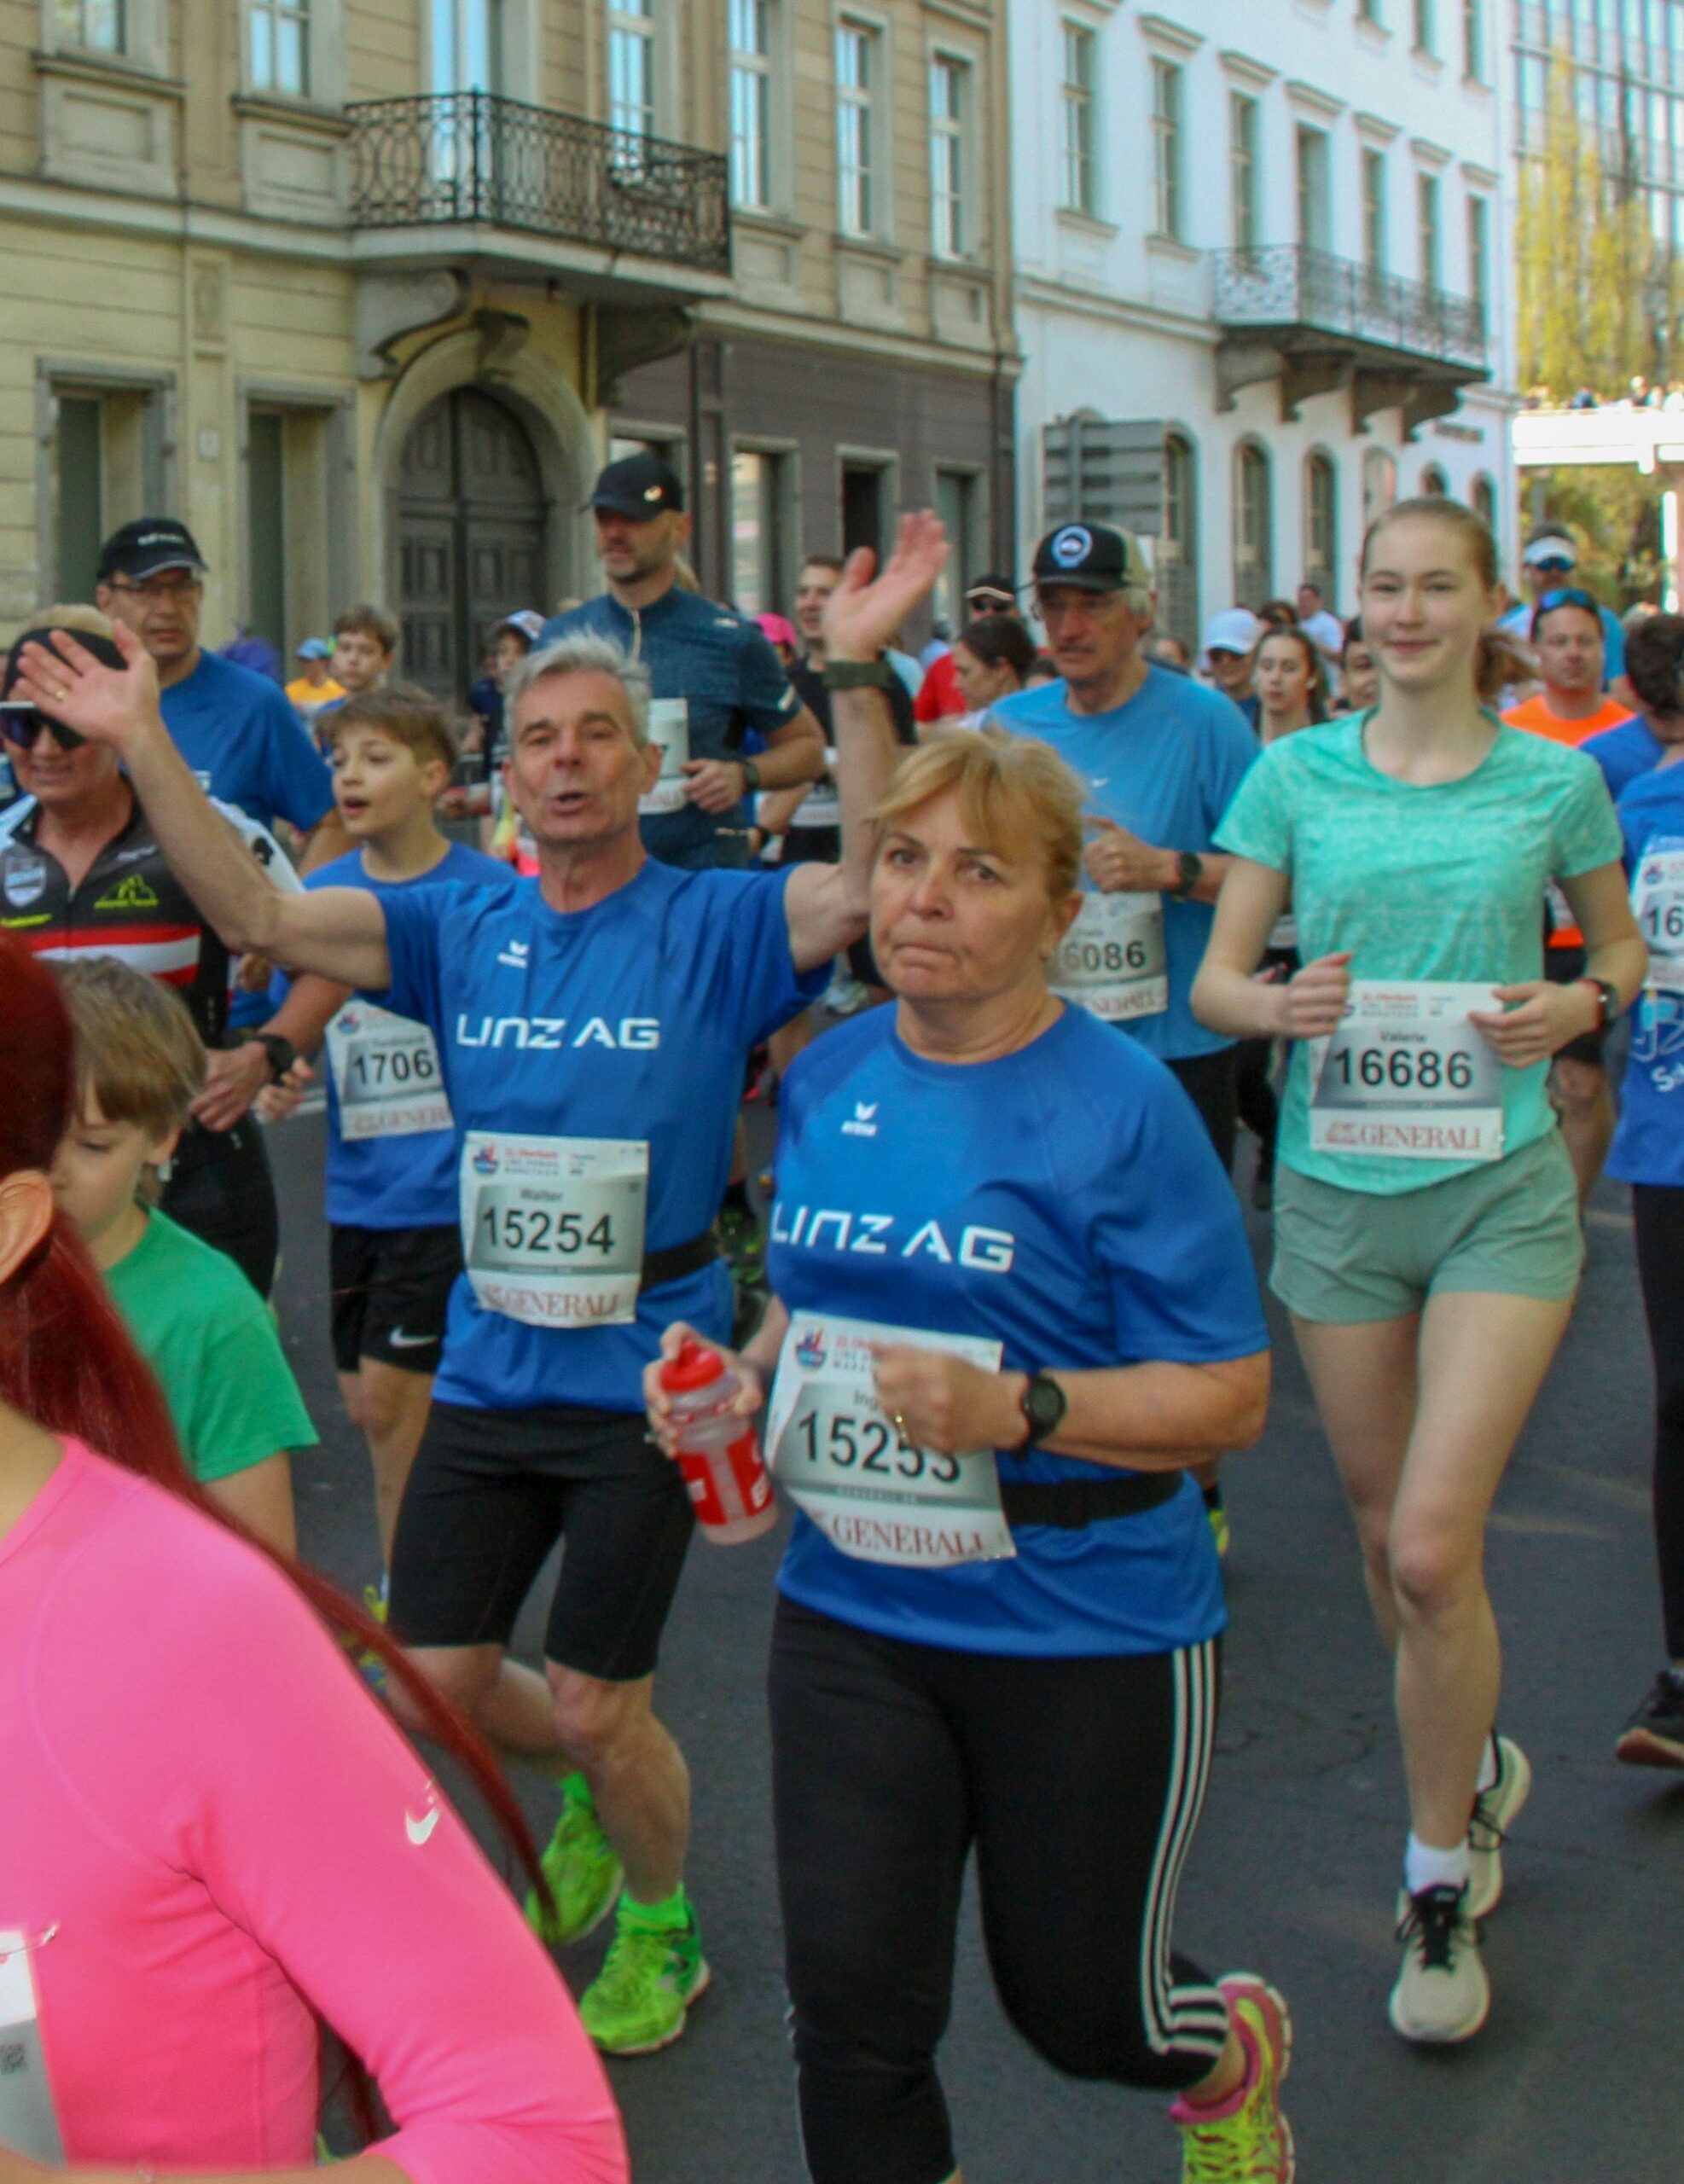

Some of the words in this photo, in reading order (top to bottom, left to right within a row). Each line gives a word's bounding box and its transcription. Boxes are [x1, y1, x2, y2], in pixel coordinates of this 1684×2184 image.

[572, 1017, 660, 1050] AG
[354, 1048, 433, 1084] 1706
[1335, 1048, 1472, 1089] 16686
[1360, 1122, 1481, 1151] GENERALI
[482, 1207, 613, 1254] 15254
[900, 1220, 1016, 1274] AG
[831, 1513, 984, 1558] GENERALI
